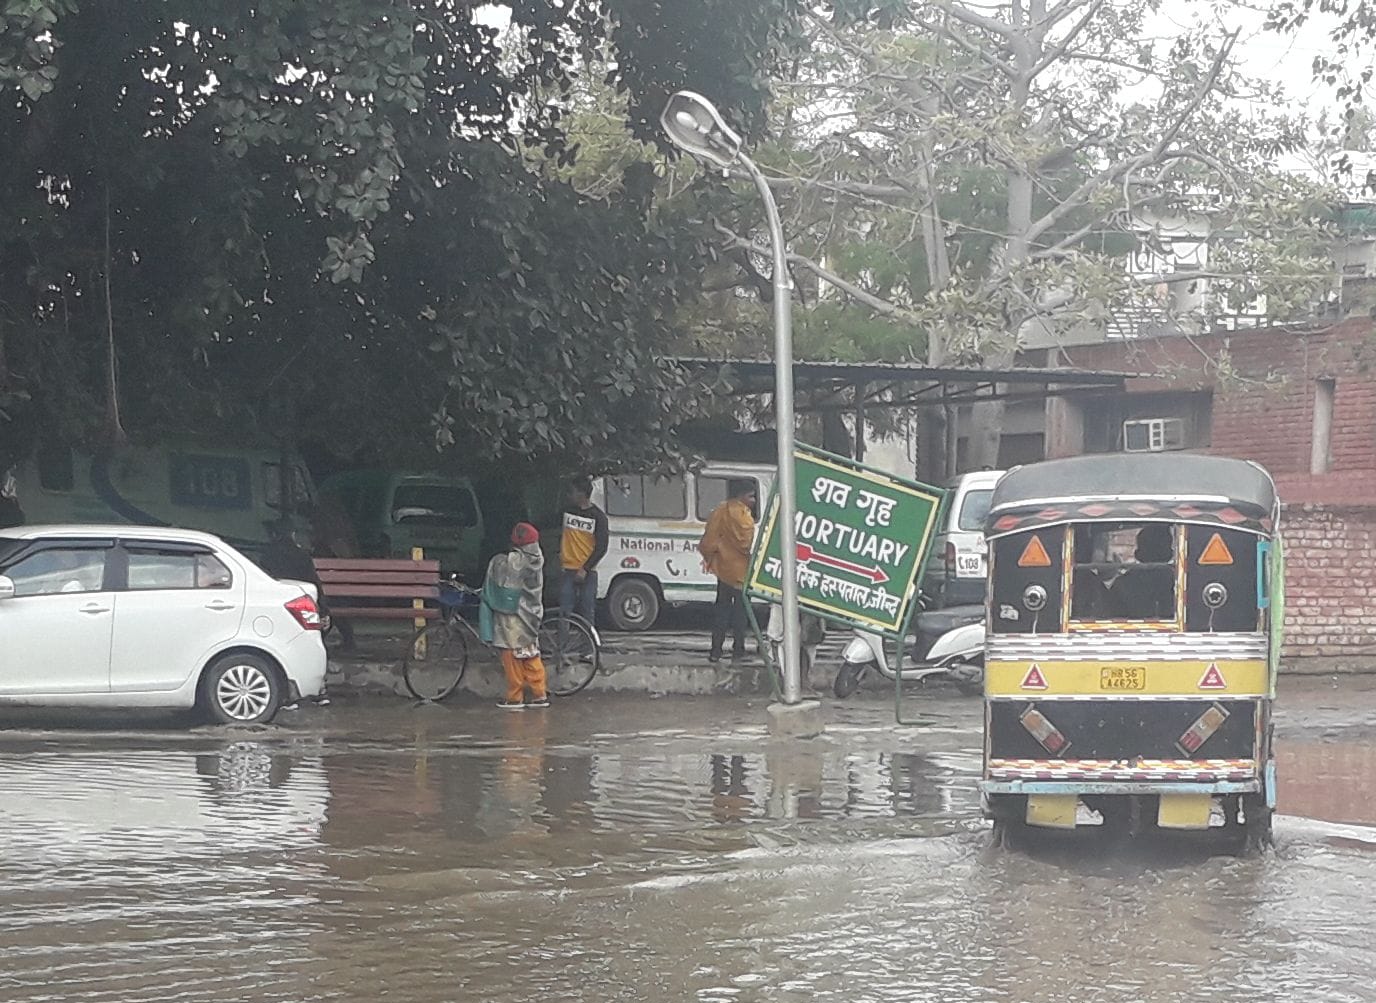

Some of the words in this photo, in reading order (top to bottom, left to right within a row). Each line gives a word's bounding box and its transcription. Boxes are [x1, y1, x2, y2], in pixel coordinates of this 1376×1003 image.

[811, 476, 852, 508] शव
[856, 489, 897, 527] गृह
[620, 538, 674, 551] National
[764, 556, 821, 589] नारिक
